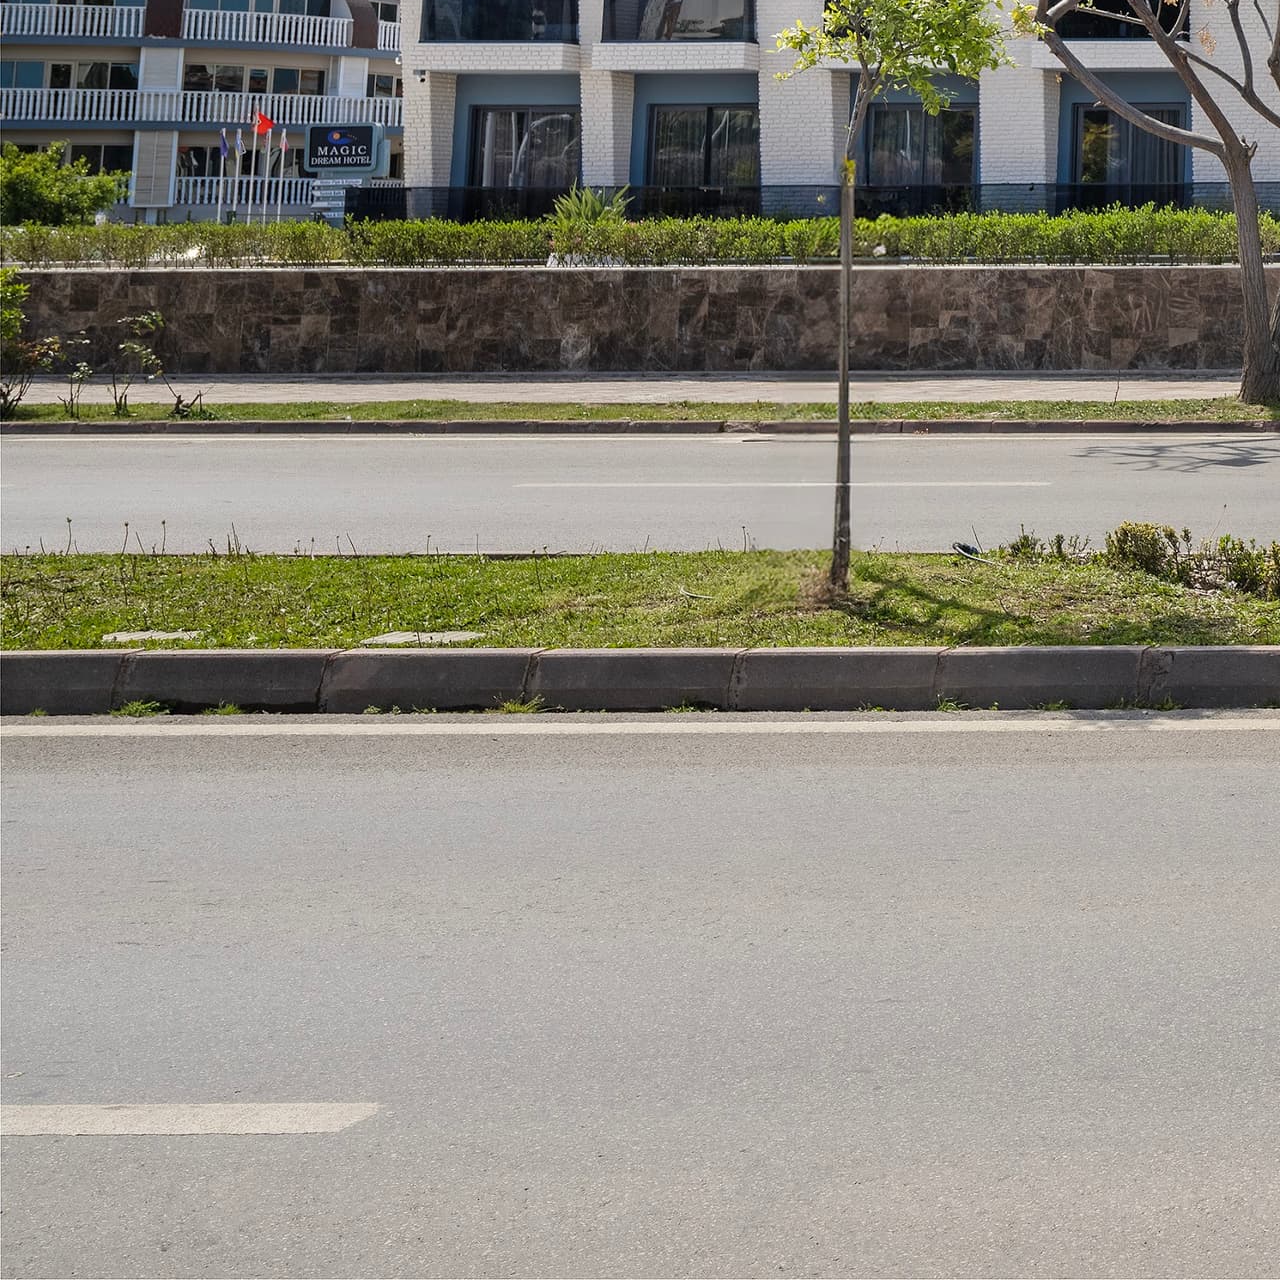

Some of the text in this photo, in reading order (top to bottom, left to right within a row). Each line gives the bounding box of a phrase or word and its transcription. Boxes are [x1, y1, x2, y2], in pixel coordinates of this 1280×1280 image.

[317, 145, 367, 156] MAGIC
[311, 156, 371, 165] DREAM HOTEL
